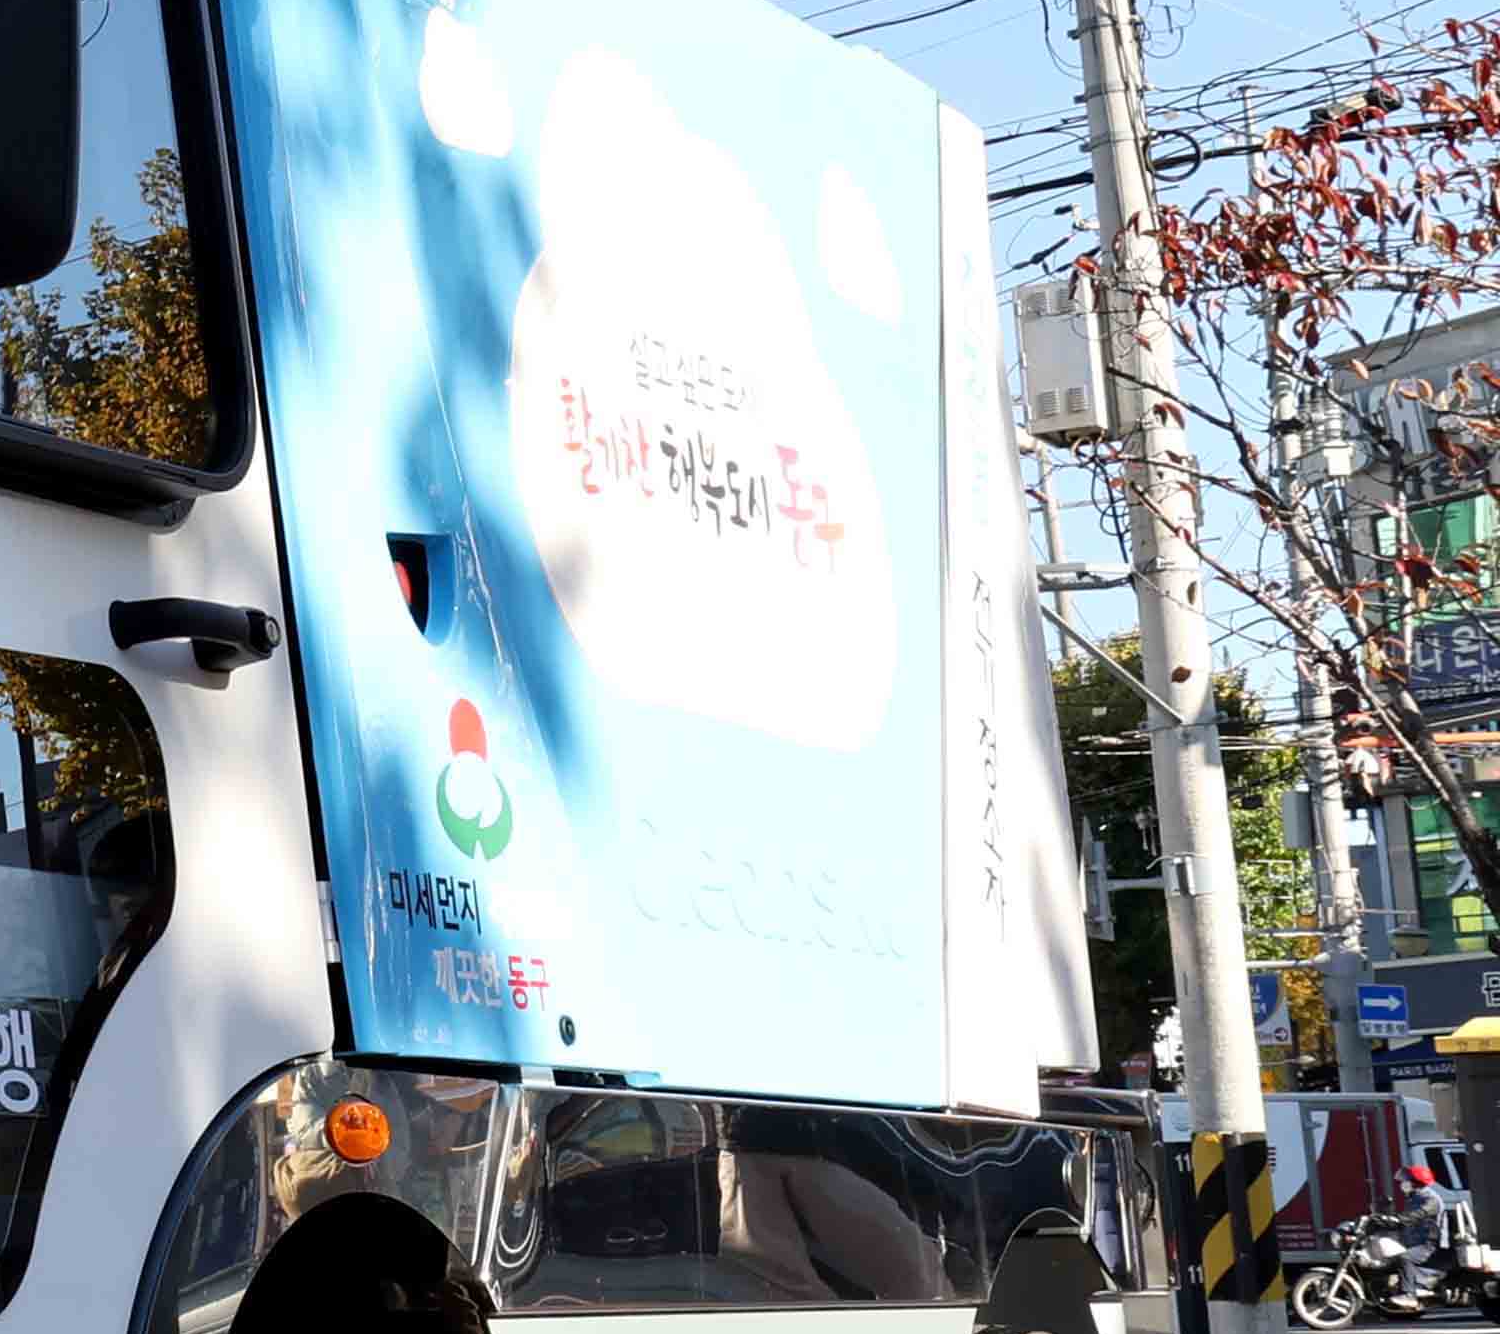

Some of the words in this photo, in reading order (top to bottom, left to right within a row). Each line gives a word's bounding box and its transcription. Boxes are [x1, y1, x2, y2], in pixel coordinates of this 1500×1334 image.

[659, 423, 771, 536] 행복도시
[774, 443, 845, 569] 동구
[389, 869, 483, 936] 미세먼지
[507, 954, 551, 1012] 동구
